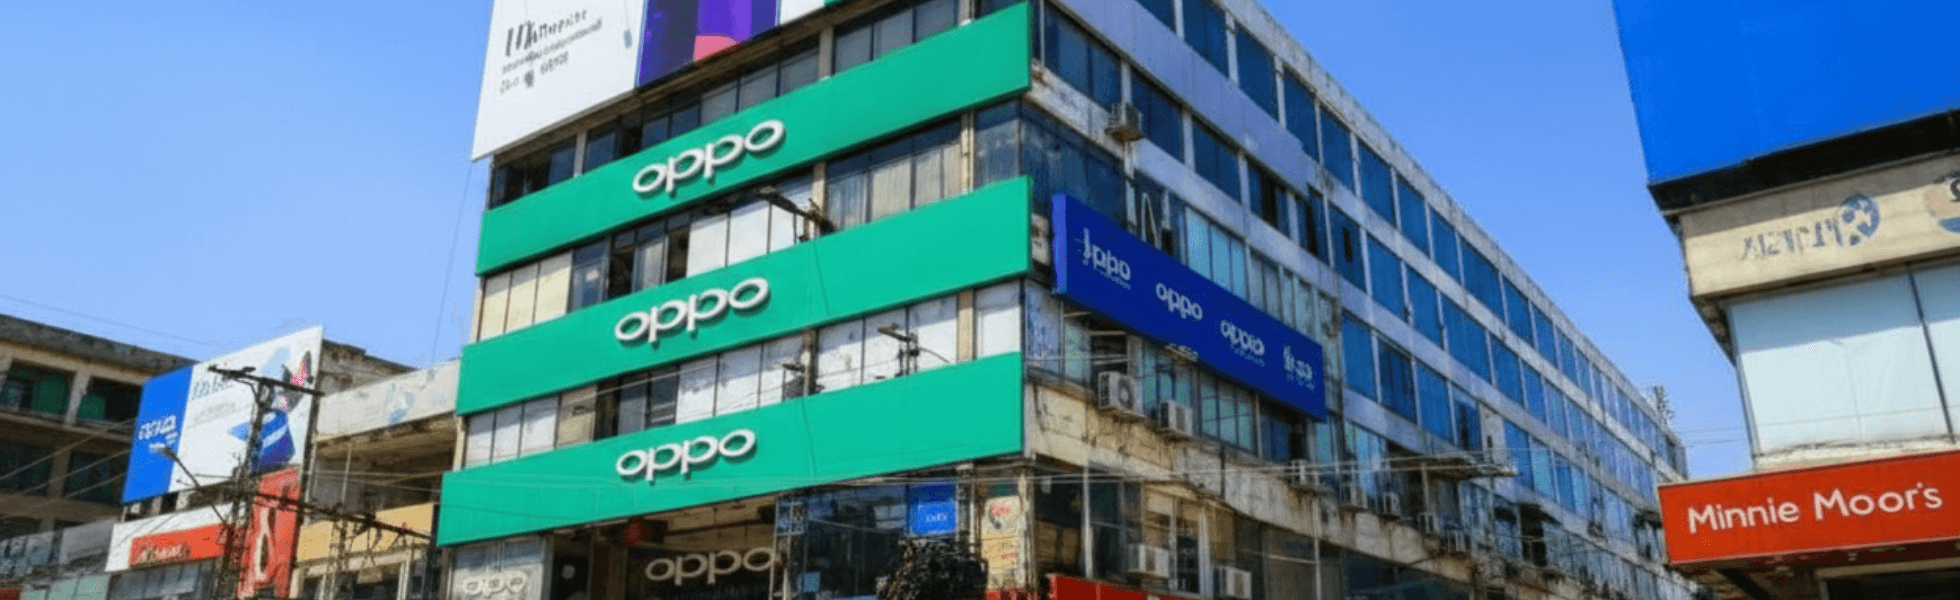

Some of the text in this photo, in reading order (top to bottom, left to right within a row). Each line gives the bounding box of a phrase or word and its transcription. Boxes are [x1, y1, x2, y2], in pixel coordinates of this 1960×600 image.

[633, 119, 785, 193] oppo
[615, 277, 769, 343] oppo
[1155, 282, 1203, 321] oppo
[616, 429, 756, 481] oppo
[1687, 482, 1943, 534] Minnie Moor's
[645, 547, 776, 586] oppo
